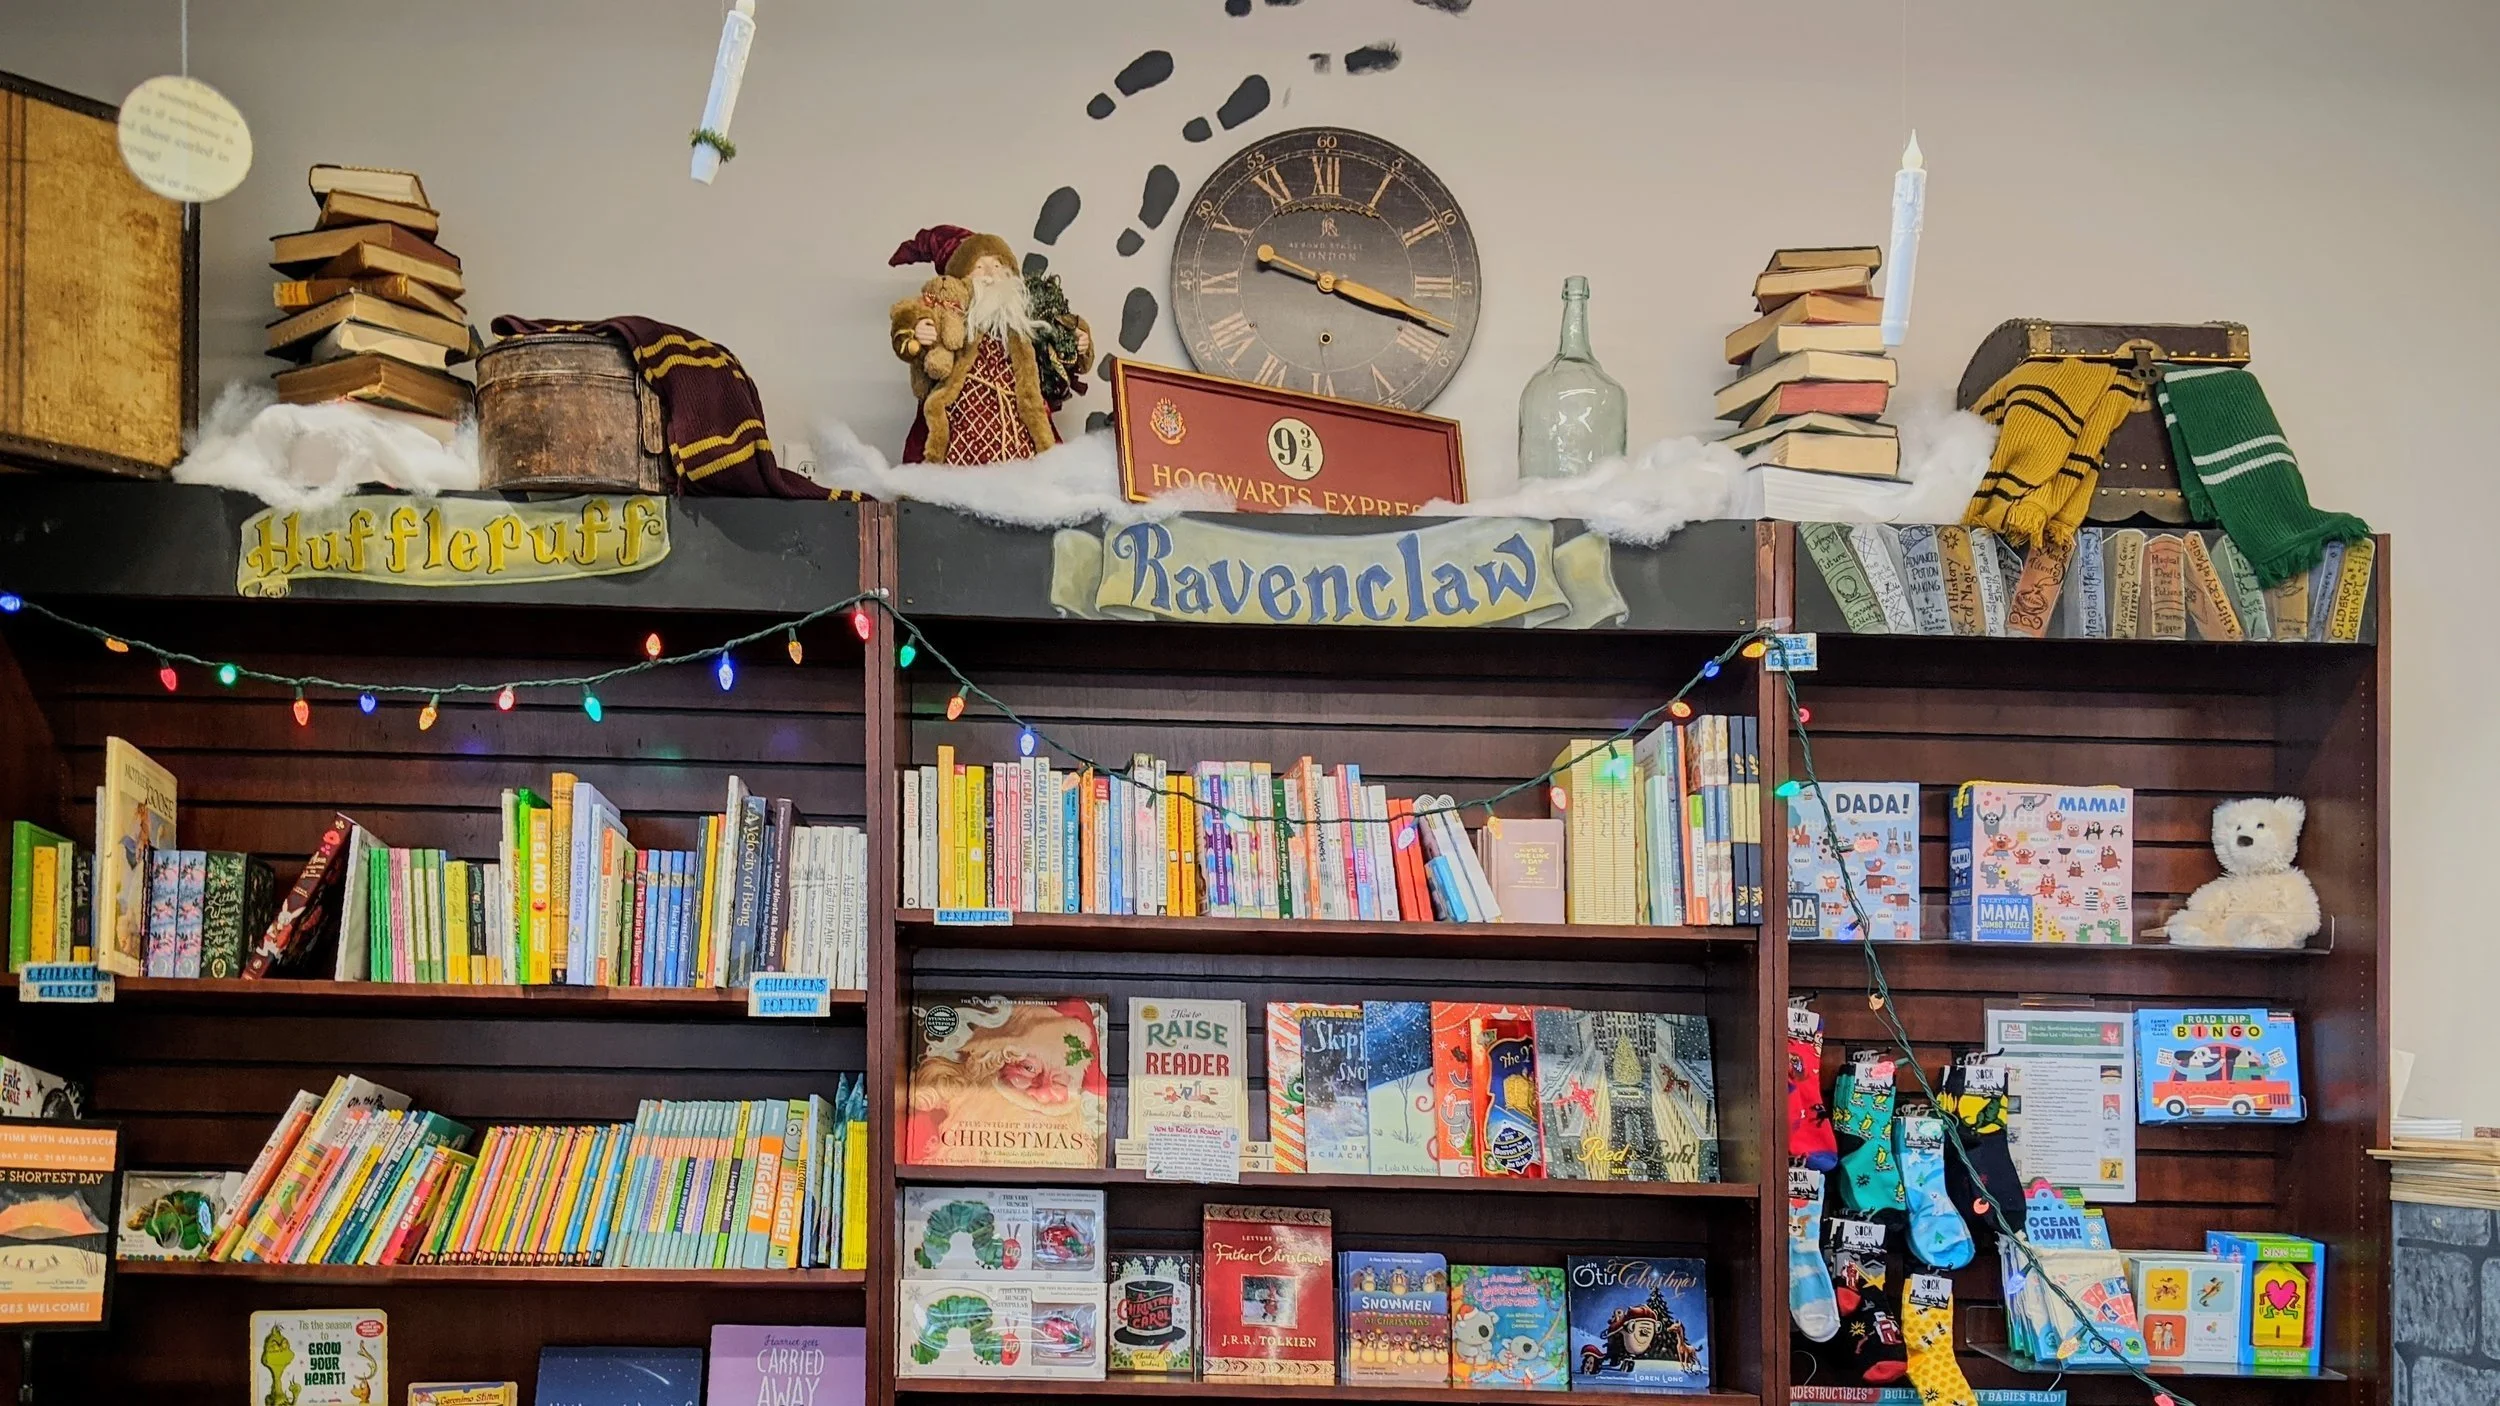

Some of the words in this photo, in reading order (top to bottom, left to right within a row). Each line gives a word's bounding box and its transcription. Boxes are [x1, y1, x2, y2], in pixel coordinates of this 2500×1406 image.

[1317, 135, 1337, 149] 60
[1246, 152, 1266, 169] 55
[1311, 156, 1341, 196] XII
[1196, 200, 1213, 221] 50
[1299, 251, 1358, 261] LONDON
[1152, 464, 1313, 507] HOGWARTS
[1323, 491, 1424, 516] EXPRE
[247, 497, 661, 574] Hufflepuff
[1904, 553, 1938, 569] ADVANCED
[1112, 523, 1538, 622] Ravenclaw
[1911, 568, 1939, 581] POTION
[1947, 558, 1960, 602] History
[1910, 582, 1940, 596] MAKING
[1960, 564, 1977, 603] Magic
[2206, 578, 2233, 626] HISTORY
[2331, 579, 2353, 638] GILDEROY
[1023, 770, 1031, 780] OH
[146, 782, 173, 820] GOOSE
[1052, 777, 1060, 810] RAISING
[907, 782, 915, 828] untangled
[1835, 793, 1910, 814] DADA!
[2058, 797, 2126, 813] MAMA!
[745, 814, 758, 824] A
[1023, 808, 1032, 833] POTTY
[1052, 813, 1060, 842] HUMAN
[1067, 821, 1074, 833] No
[742, 825, 760, 875] Velocity
[1023, 834, 1032, 873] TRAINING
[1038, 835, 1047, 872] TODDLER
[1318, 834, 1326, 862] Weeks
[1052, 846, 1060, 873] BEINGS
[1358, 849, 1366, 884] EPIDEMIC
[745, 878, 757, 892] of
[1066, 880, 1075, 900] Girls
[636, 900, 644, 918] Wind
[737, 892, 753, 927] Being
[1981, 904, 2030, 921] MAMA
[682, 915, 690, 933] Secret
[1980, 921, 2004, 929] JUMBO
[623, 922, 631, 951] Women
[670, 926, 679, 951] Beauty
[769, 927, 778, 957] Bedtime
[680, 935, 688, 961] Garden
[763, 998, 814, 1011] POETRY
[1171, 1008, 1191, 1019] How
[1793, 1012, 1808, 1023] SOCK
[2188, 1016, 2217, 1024] ROAD
[2221, 1016, 2246, 1024] TRIP
[1147, 1020, 1228, 1048] RAISE
[2177, 1026, 2260, 1038] BINGO
[1146, 1052, 1229, 1077] READER
[1500, 1055, 1519, 1068] The
[1337, 1062, 1370, 1082] SNO
[1976, 1069, 1994, 1079] SOCK
[3, 1073, 21, 1091] ERIC
[2, 1089, 21, 1105] CARLE
[1024, 1122, 1069, 1130] BEFORE
[1175, 1126, 1192, 1134] Raise
[1200, 1127, 1223, 1136] Reader
[30, 1134, 55, 1144] WITH
[58, 1135, 115, 1146] ANASTACIA
[941, 1129, 1083, 1149] CHRISTMAS
[24, 1153, 42, 1161] DEC.
[90, 1156, 108, 1164] A.M.
[1578, 1137, 1630, 1163] Red
[10, 1172, 76, 1184] SHORTEST
[79, 1173, 104, 1184] DAY
[686, 1161, 695, 1182] WAITING
[797, 1160, 807, 1191] WELCOME
[1789, 1171, 1808, 1181] SOCK
[754, 1153, 775, 1219] BIGGIE!
[401, 1196, 419, 1230] ELMO
[676, 1206, 685, 1232] EASY!
[775, 1180, 795, 1241] BIGGIE!
[2029, 1216, 2080, 1227] OCEAN
[1854, 1225, 1873, 1236] SOCK
[2034, 1228, 2083, 1240] SWIM!
[1213, 1242, 1260, 1265] Father
[1259, 1248, 1328, 1266] Christmas
[1573, 1260, 1617, 1287] Otis
[1617, 1260, 1697, 1298] Christmas
[1921, 1280, 1940, 1289] SOCK
[0, 1303, 23, 1312] GES
[27, 1302, 90, 1313] WELCOME!
[1117, 1295, 1180, 1320] CHRISTMAS
[1362, 1297, 1432, 1311] SNOWMEN
[311, 1320, 324, 1330] the
[325, 1321, 352, 1330] season
[1132, 1311, 1170, 1328] CAROL
[1365, 1317, 1376, 1325] AT
[1376, 1317, 1430, 1326] CHRISTMAS
[320, 1332, 329, 1340] to
[764, 1335, 801, 1347] Harriet
[801, 1339, 819, 1348] gets
[1222, 1336, 1255, 1347] J.R.R.
[1259, 1336, 1317, 1348] TOLKIEN
[308, 1342, 341, 1355] GROW
[1135, 1352, 1156, 1360] Charles
[310, 1358, 340, 1371] YOUR
[757, 1348, 825, 1376] CARRIED
[304, 1372, 346, 1386] HEART!
[1635, 1374, 1660, 1382] LOREN
[1663, 1375, 1683, 1383] LONG
[440, 1395, 474, 1404] Geronimo
[477, 1393, 500, 1402] Stilton
[757, 1375, 820, 1406] AWAY
[1885, 1389, 1914, 1398] BUILT
[1989, 1392, 2026, 1401] BABIES
[2029, 1393, 2061, 1402] READ!
